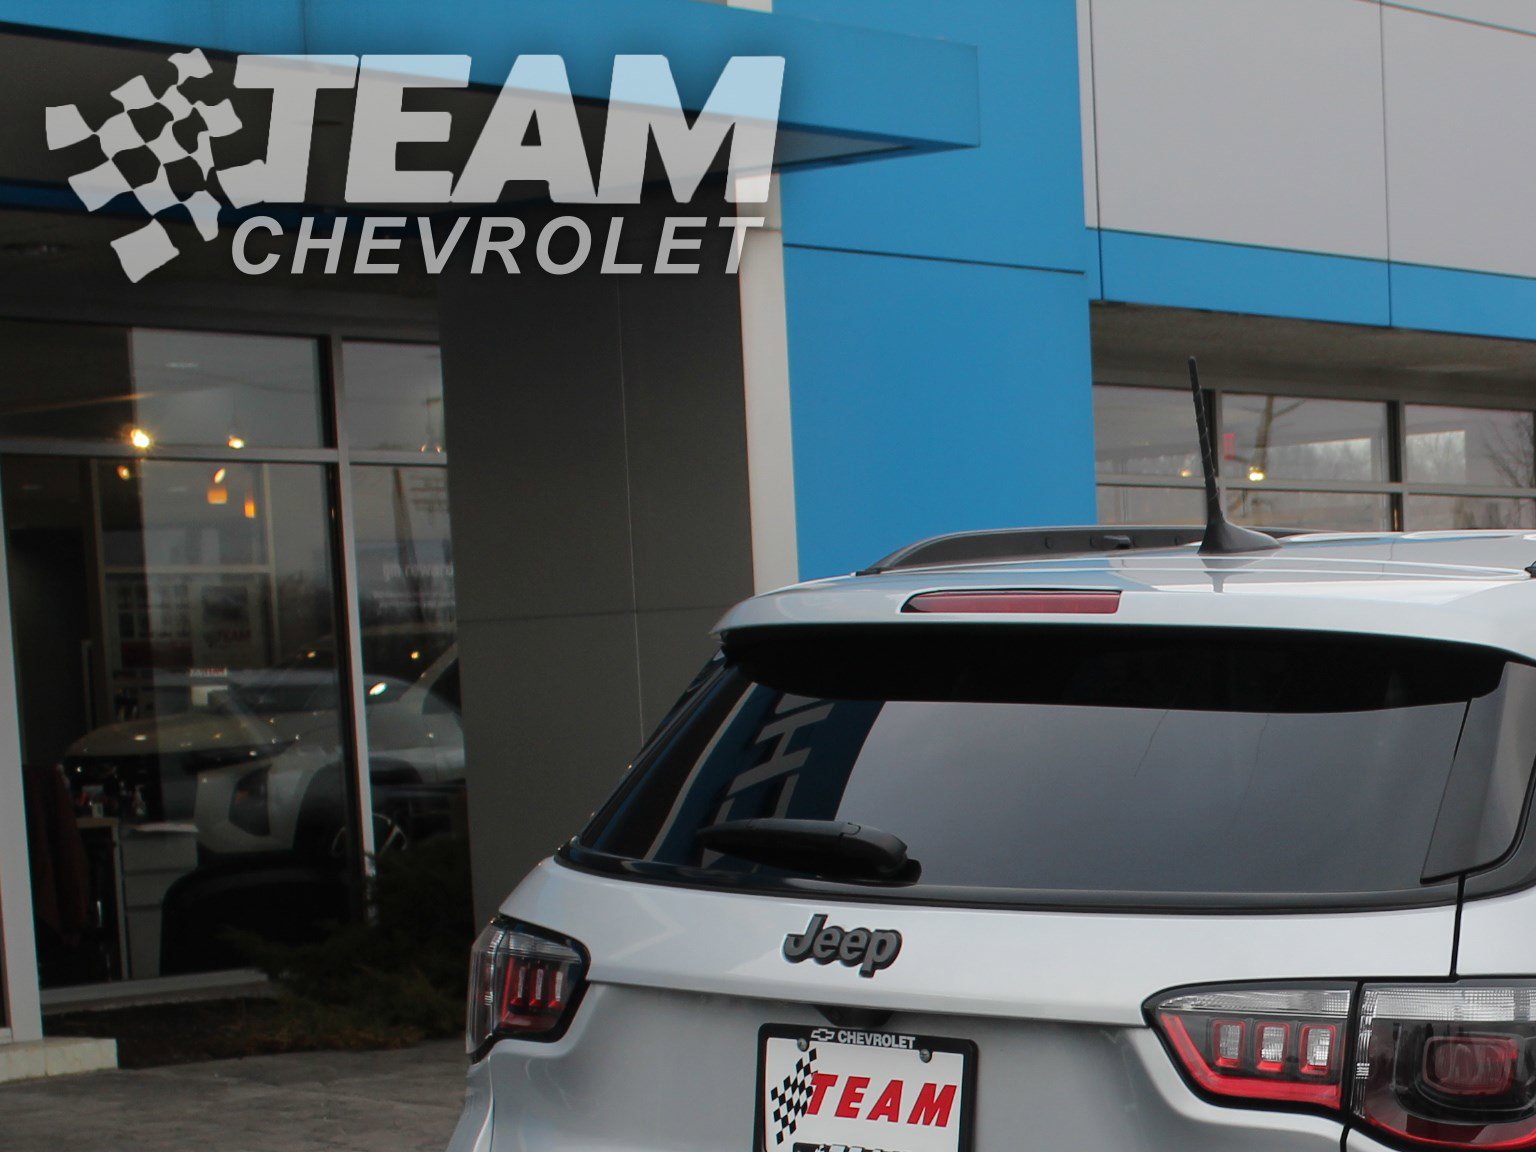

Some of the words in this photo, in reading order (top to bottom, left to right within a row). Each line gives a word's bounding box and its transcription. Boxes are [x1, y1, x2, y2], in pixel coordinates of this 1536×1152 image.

[783, 913, 902, 977] Jeep
[838, 1030, 916, 1049] CHEVROLET
[806, 1073, 957, 1127] TEAM
